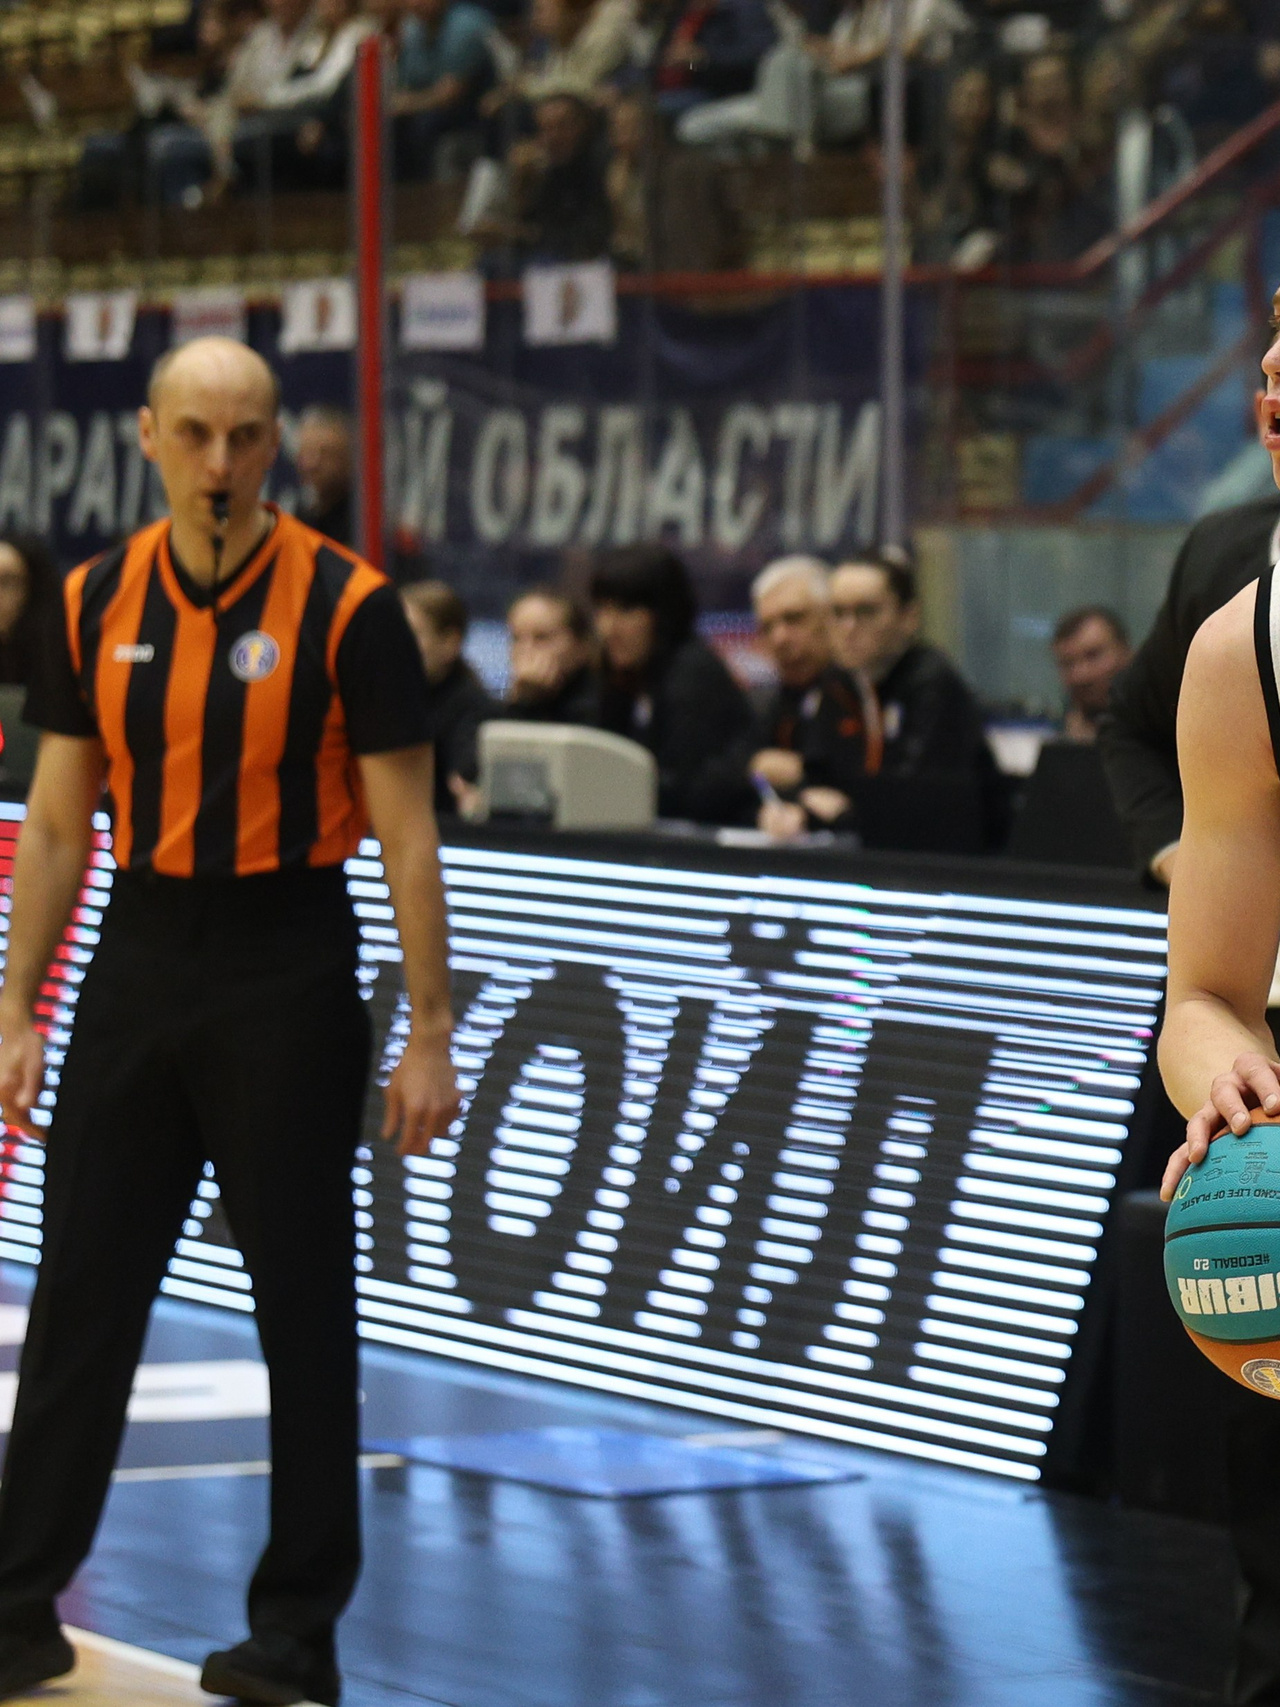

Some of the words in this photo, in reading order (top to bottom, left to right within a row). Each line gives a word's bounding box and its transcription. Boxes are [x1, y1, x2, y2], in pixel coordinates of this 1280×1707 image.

[471, 400, 883, 549] ОБЛАСТИ
[1213, 1189, 1225, 1200] OF
[1228, 1188, 1251, 1198] LIFE
[1180, 1192, 1211, 1212] PLASTIC
[1193, 1258, 1210, 1271] 2.0
[1212, 1253, 1270, 1269] #ECOBALL
